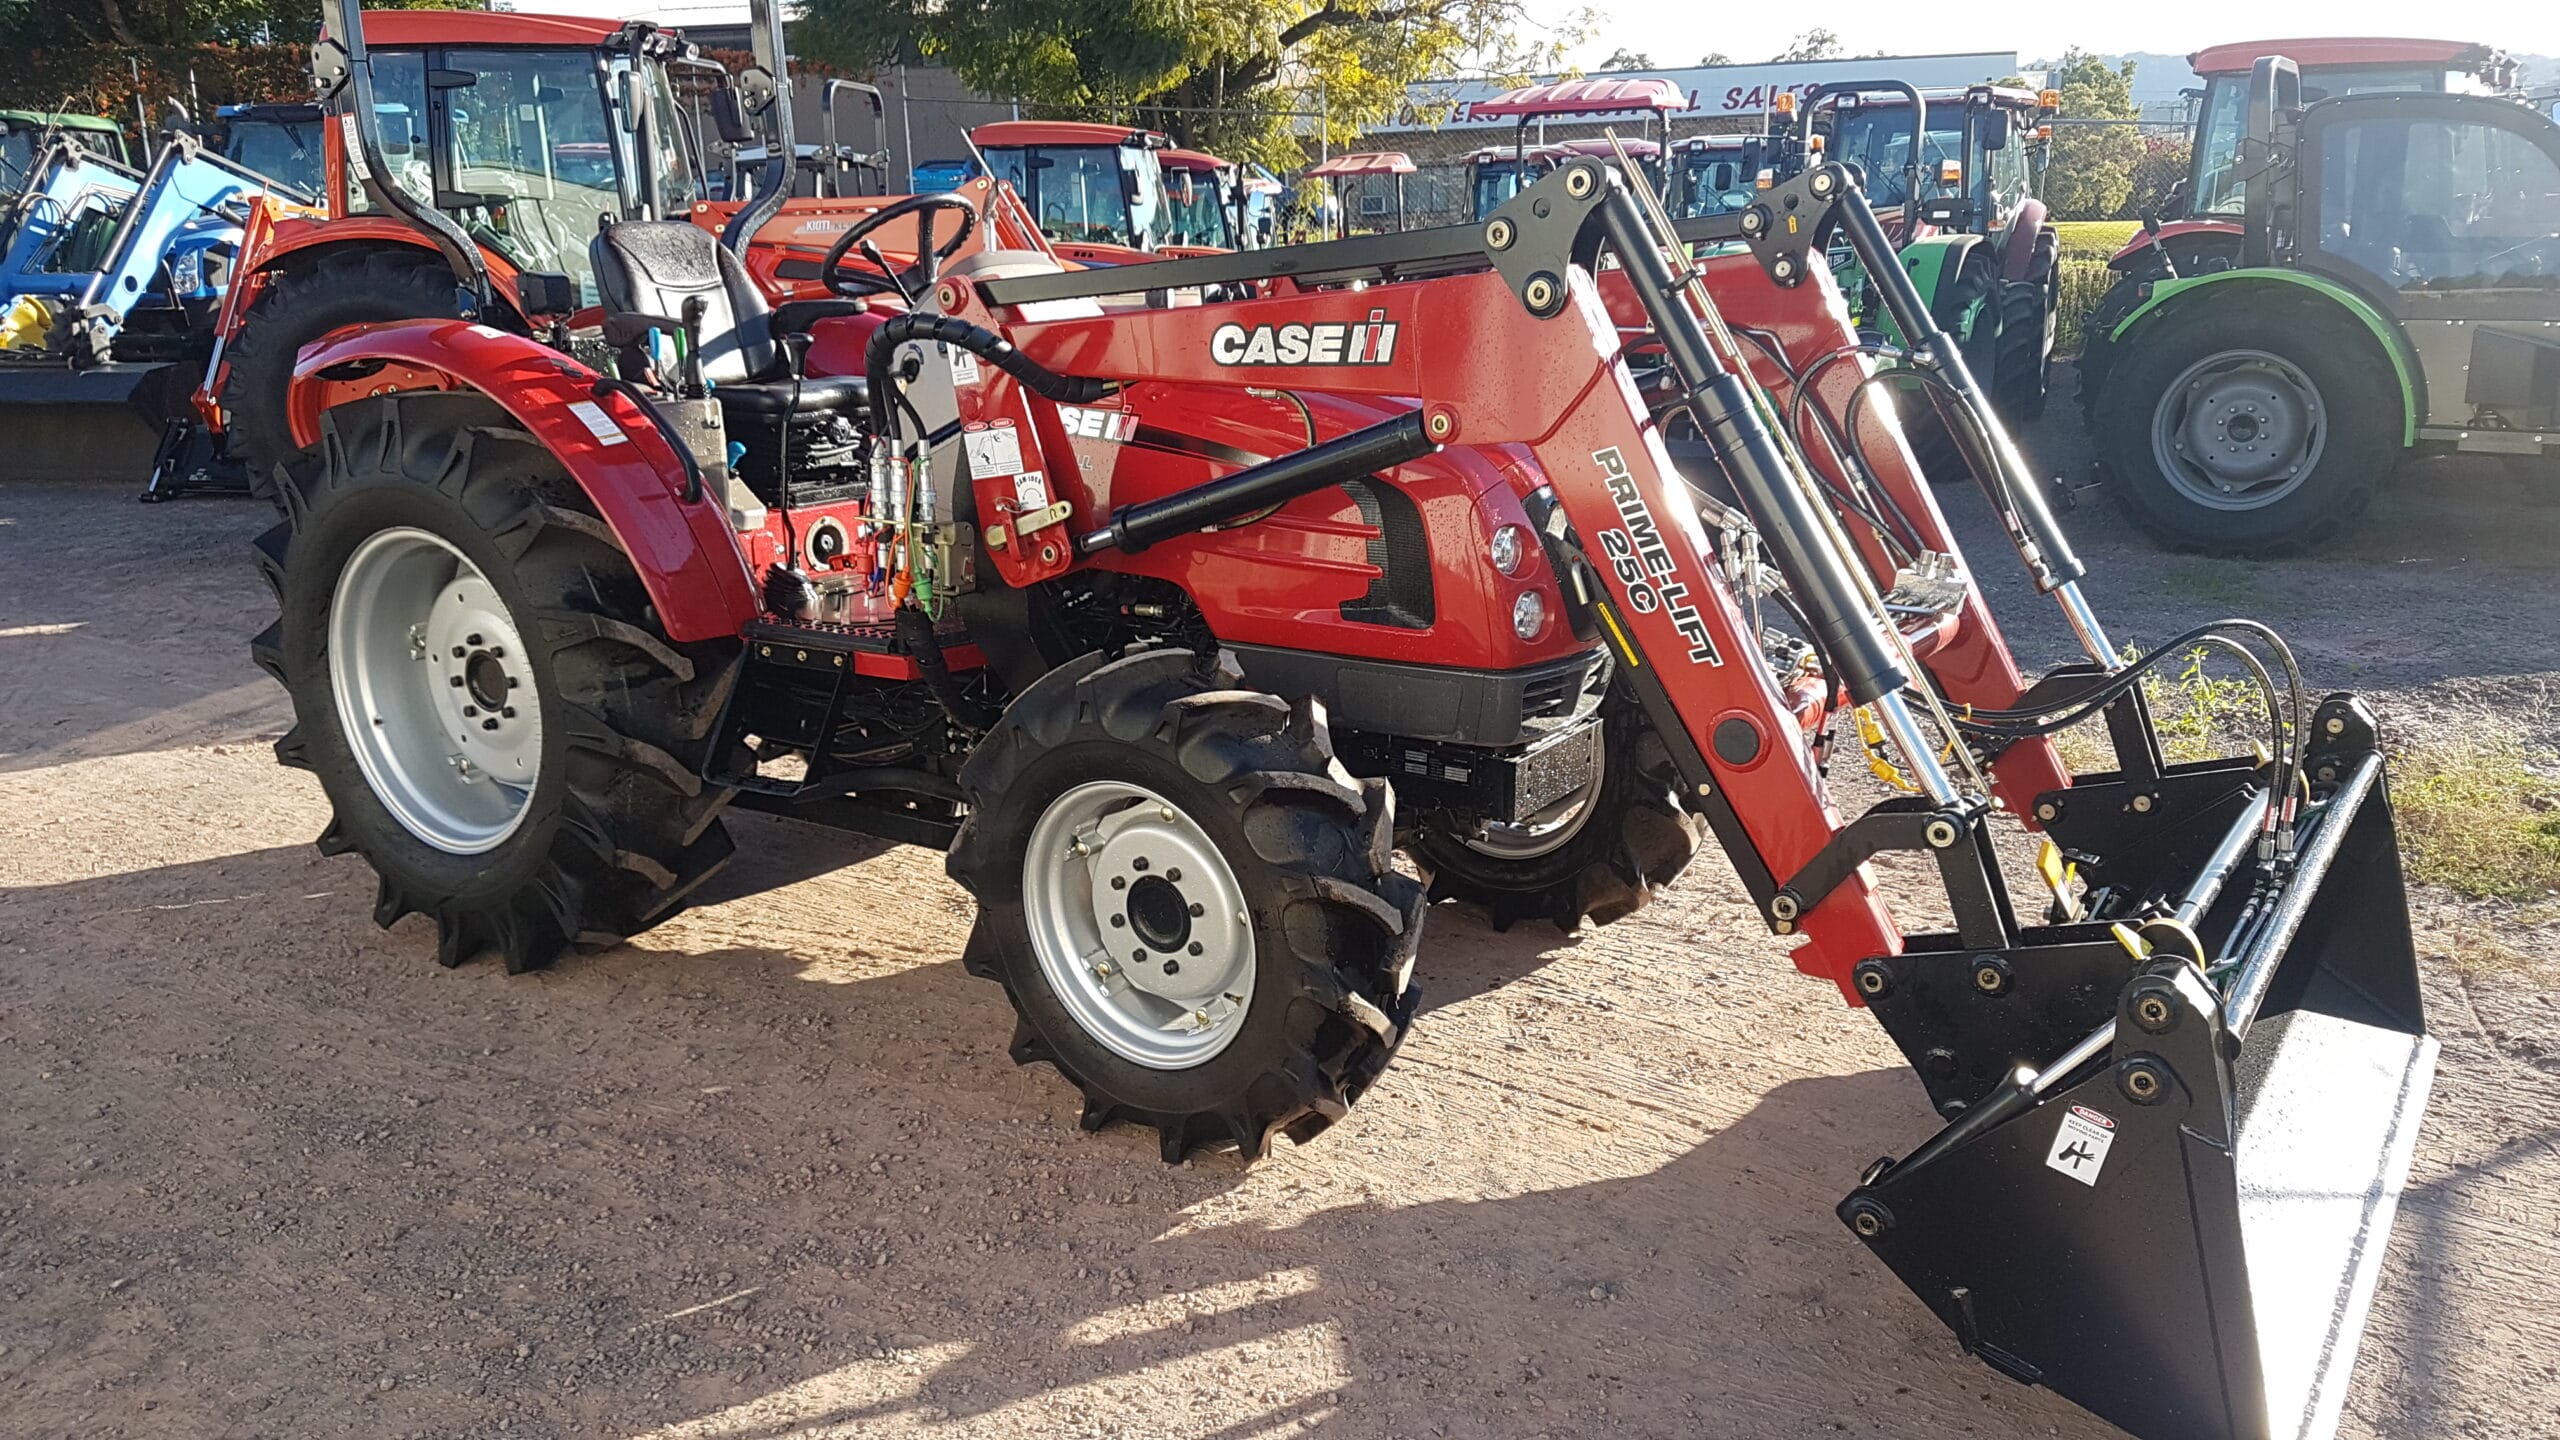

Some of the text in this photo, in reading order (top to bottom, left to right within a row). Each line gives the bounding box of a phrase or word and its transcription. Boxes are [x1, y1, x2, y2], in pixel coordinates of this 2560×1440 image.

[1211, 324, 1346, 365] CASE
[1592, 446, 1723, 667] PRIME-LIFT
[2068, 1119, 2082, 1127] KEEP
[2082, 1125, 2100, 1136] CLEAR
[2079, 1108, 2107, 1124] DANGER
